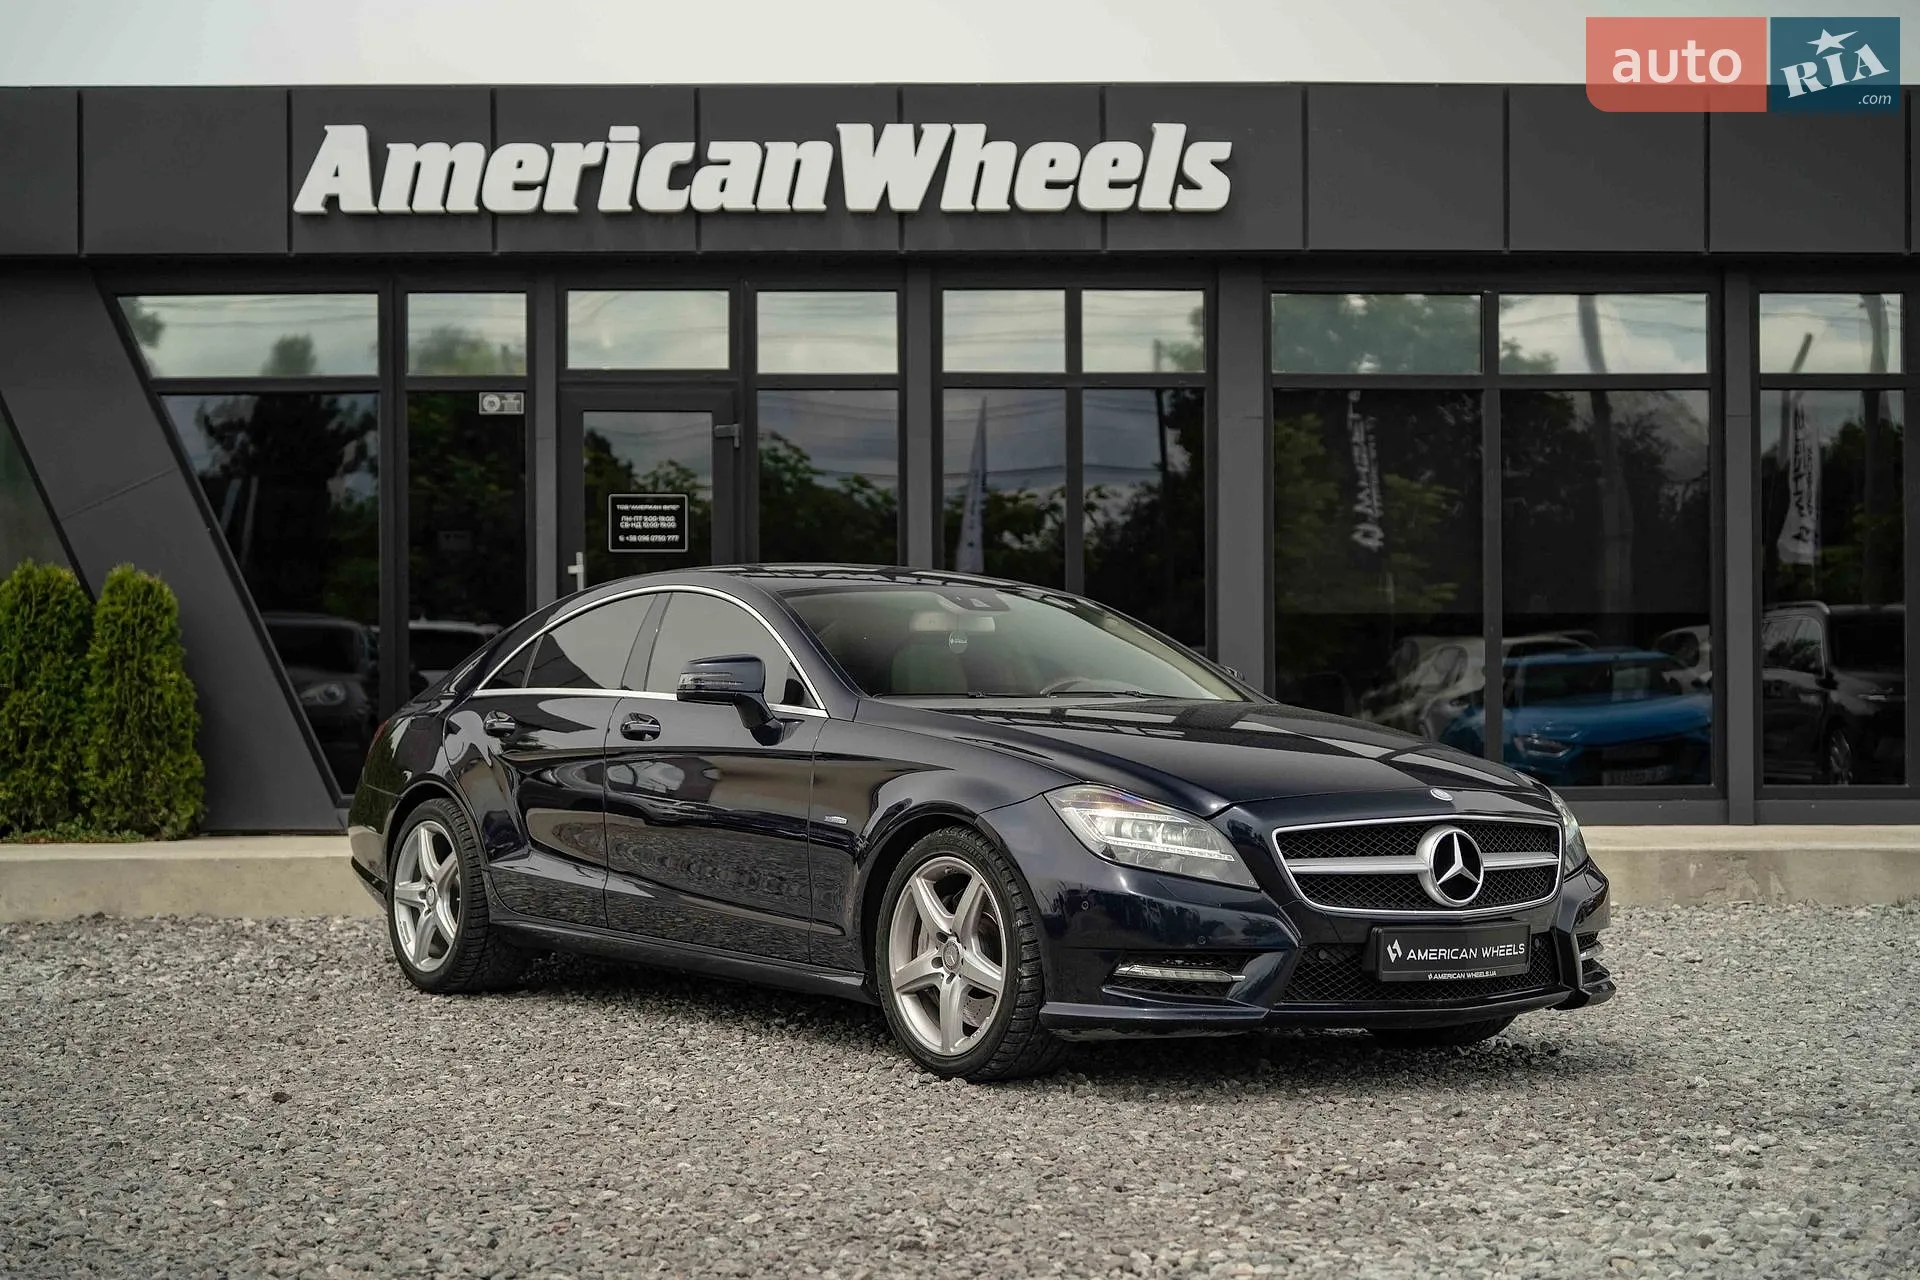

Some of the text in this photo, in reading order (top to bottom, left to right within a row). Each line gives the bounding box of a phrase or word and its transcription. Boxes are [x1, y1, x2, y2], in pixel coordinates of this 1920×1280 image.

[294, 123, 1232, 215] AmericanWheels
[1406, 943, 1526, 961] AMERICAN WHEELS
